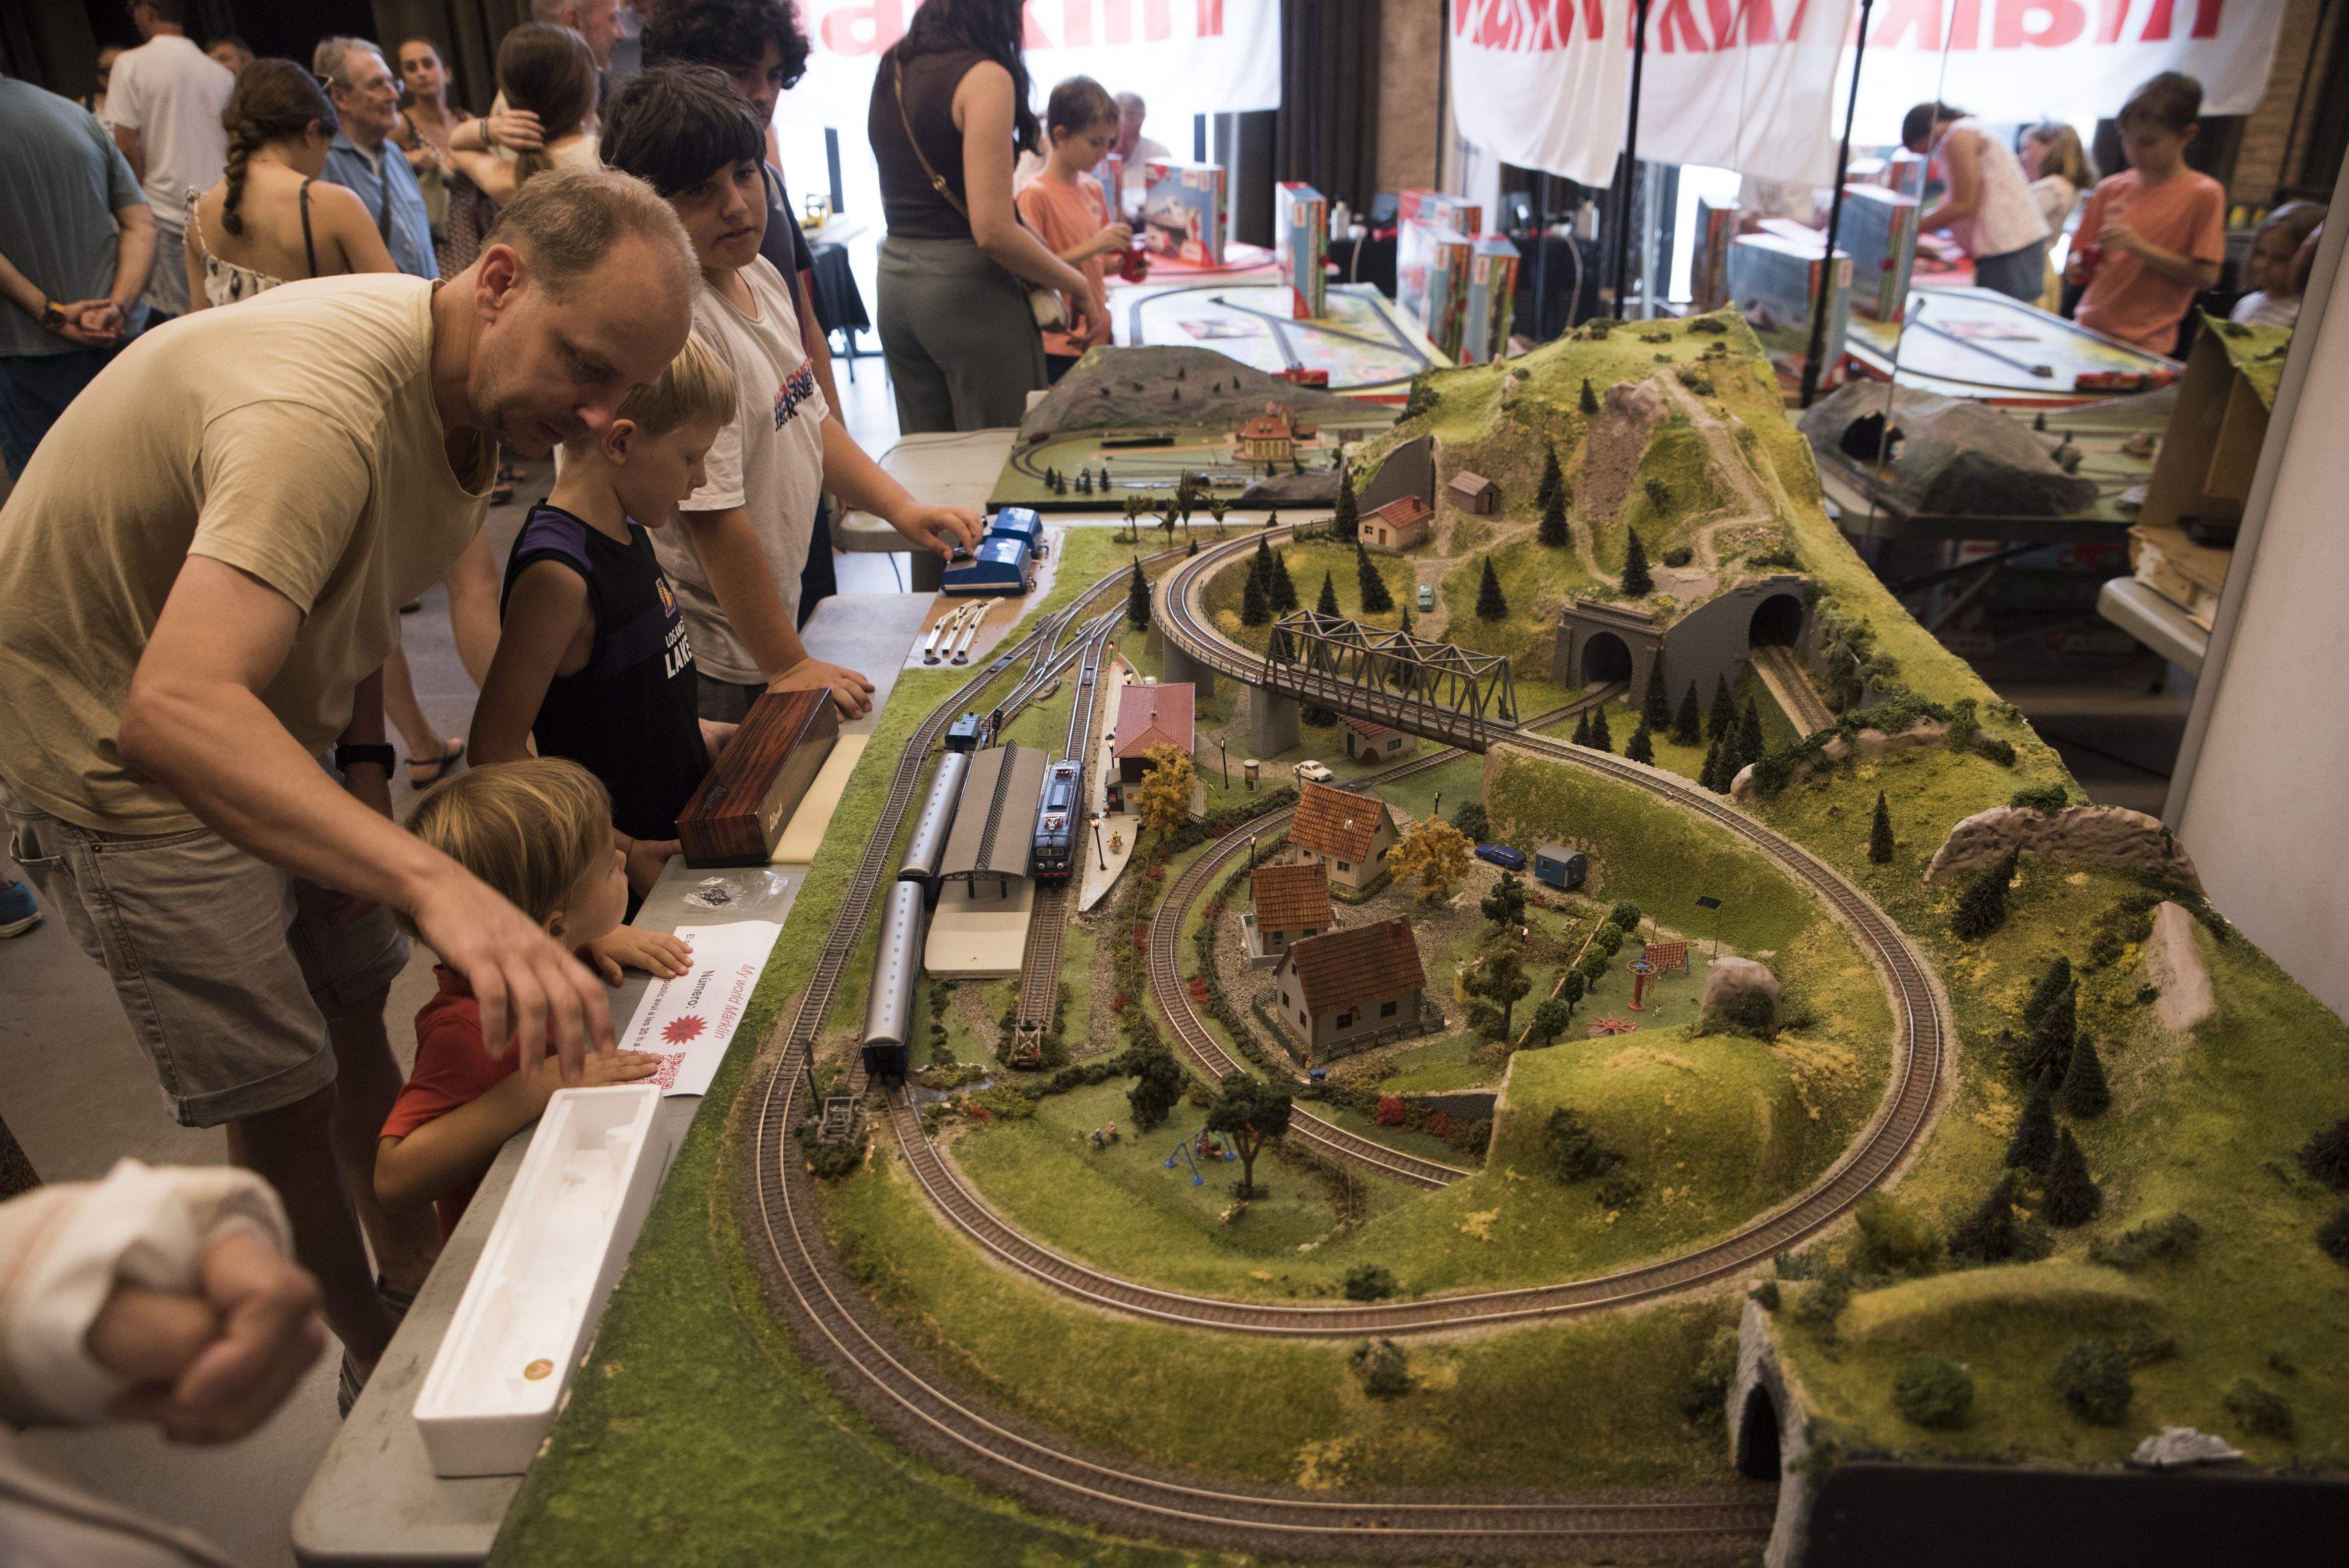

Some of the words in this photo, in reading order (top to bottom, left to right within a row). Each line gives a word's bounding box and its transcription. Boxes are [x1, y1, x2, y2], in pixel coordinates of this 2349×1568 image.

[665, 629, 678, 649] LOS
[665, 634, 693, 679] LAKE
[736, 964, 755, 979] My
[686, 970, 715, 1008] Número:
[728, 979, 747, 1006] world
[650, 998, 662, 1010] avui
[643, 1016, 655, 1026] les
